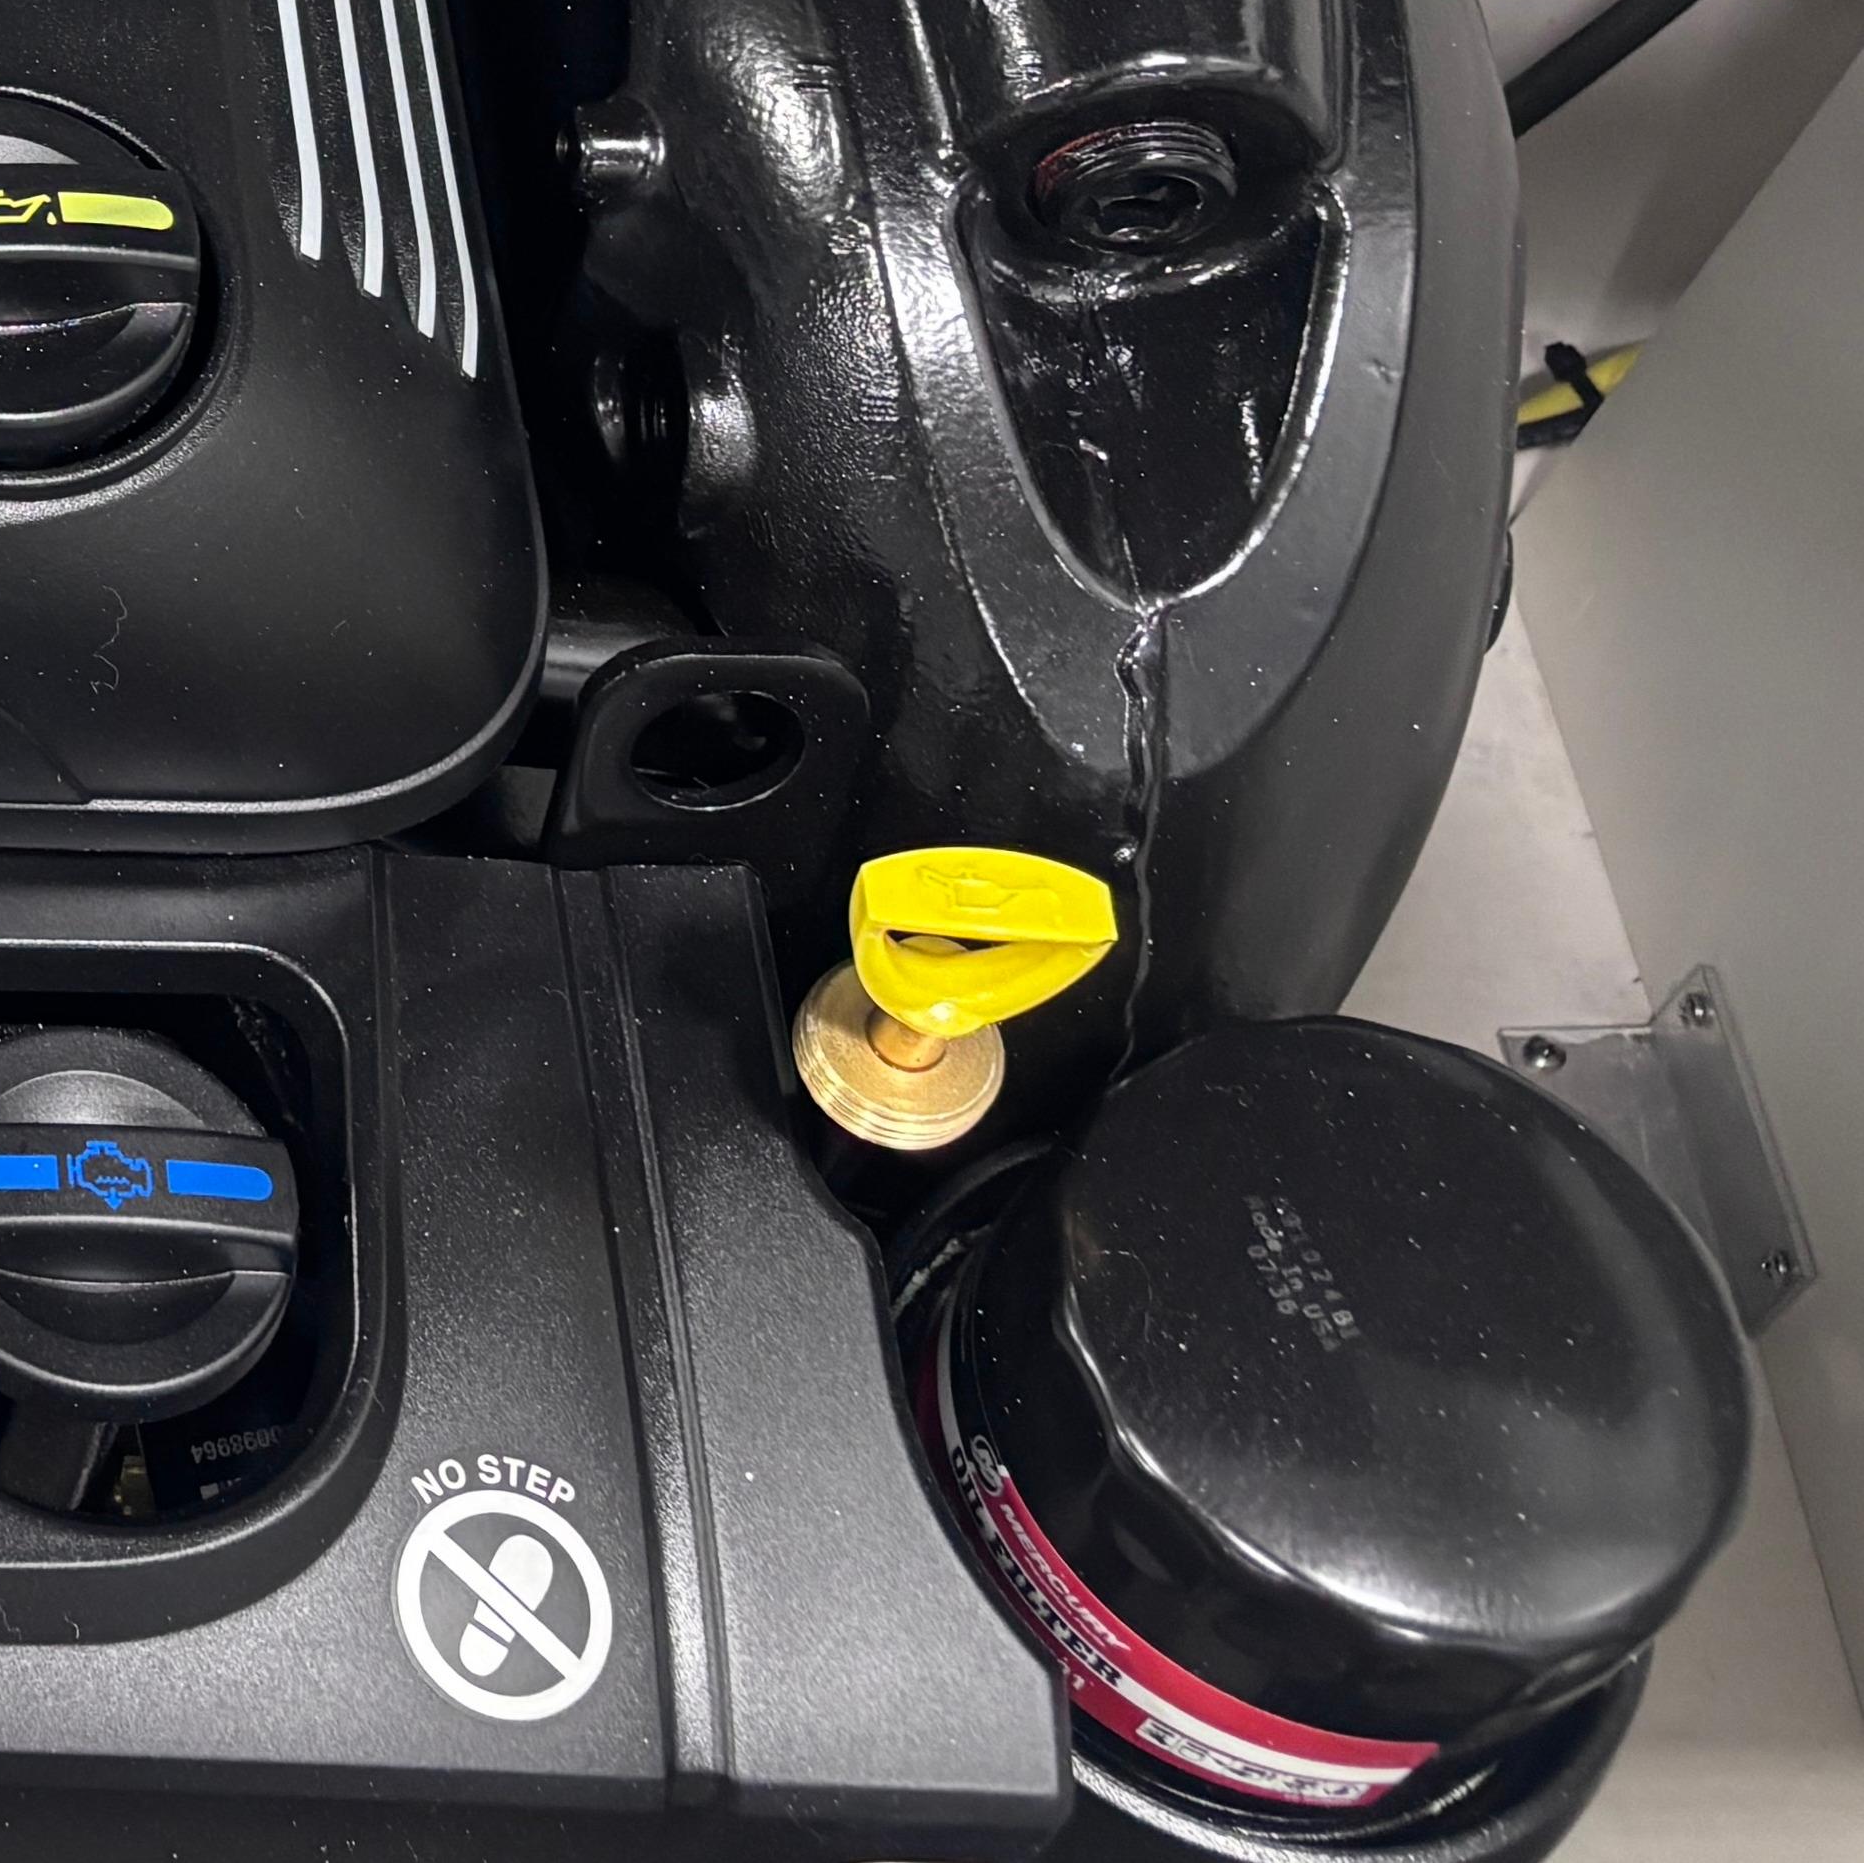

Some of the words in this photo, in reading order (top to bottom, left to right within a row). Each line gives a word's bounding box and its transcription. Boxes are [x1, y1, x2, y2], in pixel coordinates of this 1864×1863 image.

[412, 1459, 467, 1504] NO
[477, 1454, 576, 1505] STEP
[1000, 1503, 1131, 1651] MERCURY
